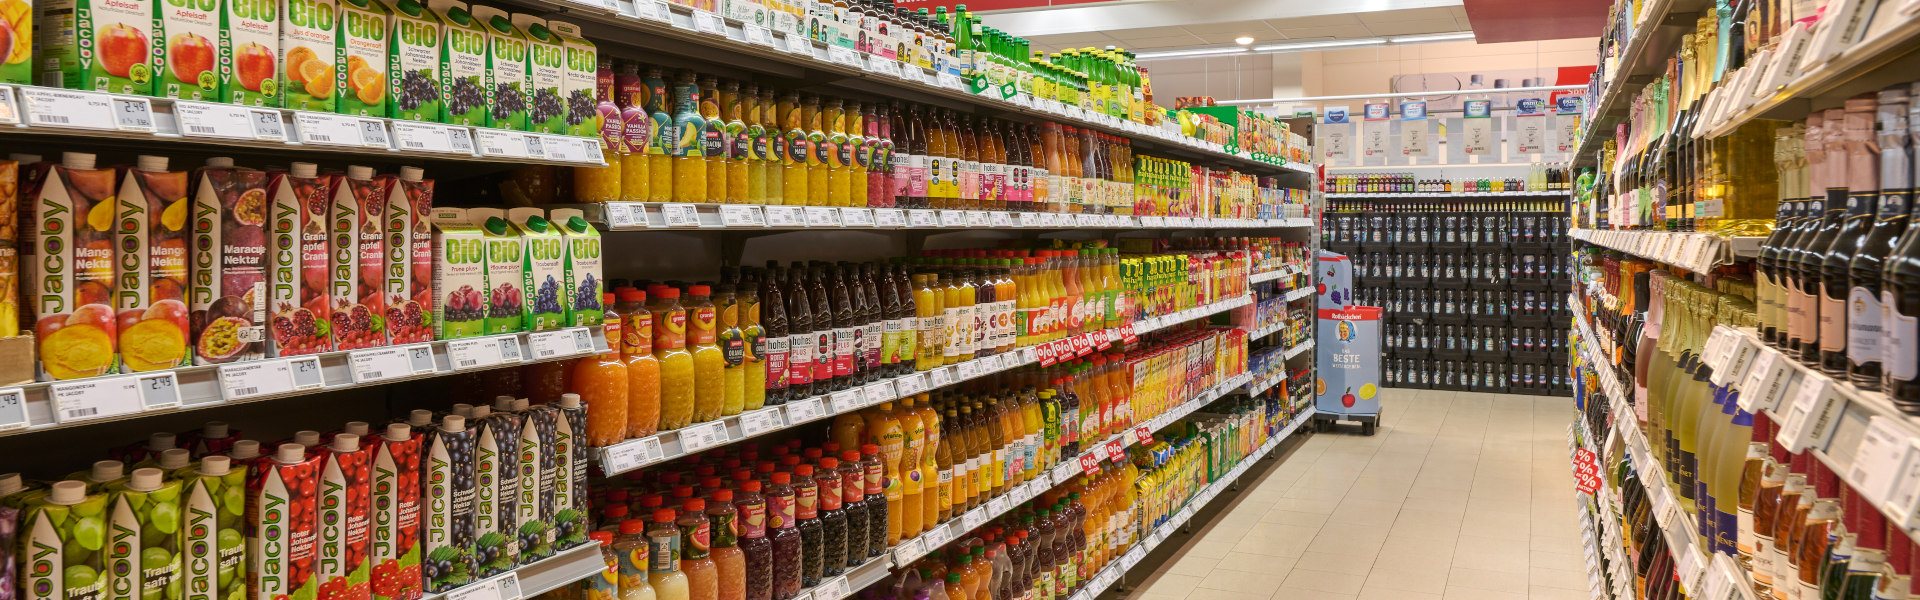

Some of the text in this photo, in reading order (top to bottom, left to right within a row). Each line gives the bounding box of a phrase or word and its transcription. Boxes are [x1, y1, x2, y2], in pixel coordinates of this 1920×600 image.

[176, 9, 208, 20] Apfelsaft
[241, 20, 269, 31] Apfelsaft
[293, 28, 304, 36] Jus
[78, 8, 93, 70] Jacoby
[152, 18, 164, 77] Jacoby
[219, 29, 231, 84] Jacoby
[349, 38, 382, 50] Orangensaft
[336, 48, 347, 98] Jacoby
[391, 54, 402, 103] Jacoby
[441, 61, 452, 109] Jacoby
[485, 68, 495, 113] Jacoby
[125, 101, 146, 113] 2.49
[525, 74, 534, 118] Jacoby
[260, 113, 277, 124] 2.49
[41, 198, 69, 314] Jacoby
[119, 199, 145, 309] Jacoby
[194, 200, 218, 304] Jacoby
[224, 255, 260, 265] Nektar
[275, 201, 298, 300] Jacoby
[302, 241, 325, 251] apfel
[333, 202, 356, 297] Jacoby
[360, 241, 380, 251] apfel
[387, 203, 409, 293] Jacoby
[413, 241, 430, 249] apfel
[525, 271, 535, 315] Jacoby
[565, 269, 576, 311] Jacoby
[299, 360, 316, 372] 2.49
[791, 348, 807, 356] PLUS
[1333, 353, 1361, 364] BESTE
[151, 377, 172, 390] 2.49
[477, 447, 496, 529] Jacoby
[520, 438, 538, 517] Jacoby
[554, 430, 571, 506] Jacoby
[373, 467, 395, 557] Jacoby
[399, 500, 414, 509] Roter
[429, 456, 449, 543] Jacoby
[500, 489, 515, 497] Nektar
[291, 529, 310, 540] Roter
[320, 480, 343, 574] Jacoby
[347, 514, 364, 525] Roter
[347, 527, 367, 536] Nektar
[399, 512, 417, 521] Nektar
[219, 557, 238, 569] saft
[262, 493, 286, 592] Jacoby
[291, 542, 313, 553] Nektar
[30, 540, 58, 600] oby
[143, 576, 168, 589] saft
